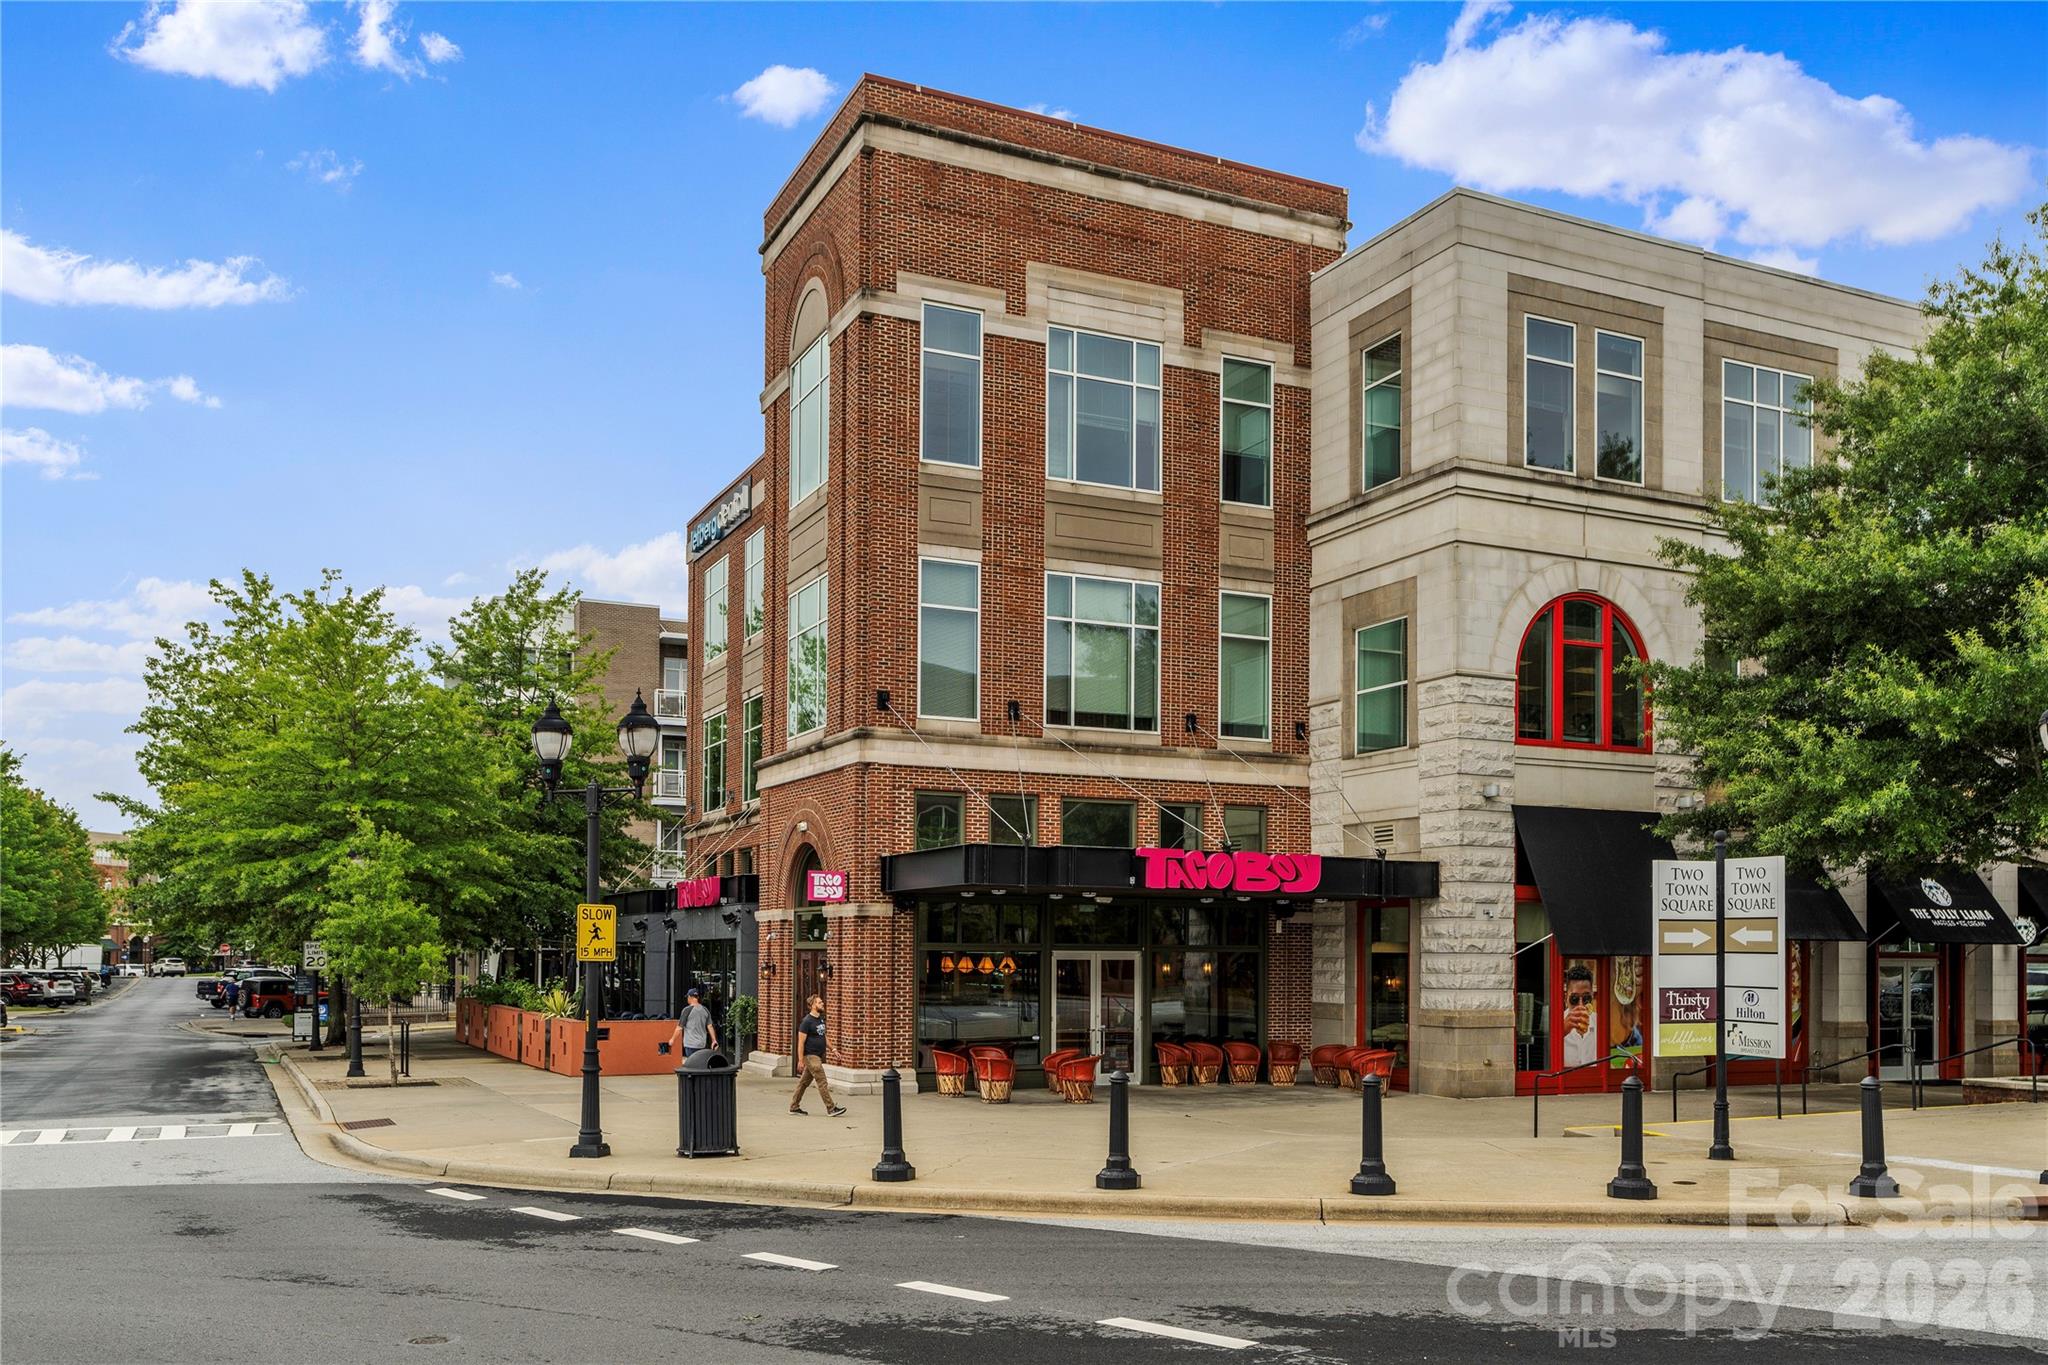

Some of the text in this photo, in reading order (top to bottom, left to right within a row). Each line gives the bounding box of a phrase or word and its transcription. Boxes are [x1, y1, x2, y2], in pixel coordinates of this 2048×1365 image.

[811, 873, 842, 886] TACO
[1671, 867, 1704, 881] TWO
[1736, 867, 1766, 879] TWO
[813, 885, 843, 898] BOY
[1665, 883, 1708, 896] TOWN
[1731, 882, 1771, 895] TOWN
[1661, 898, 1714, 914] SQUARE
[1727, 898, 1776, 913] SQUARE
[582, 908, 612, 920] SLOW
[1910, 908, 1994, 920] THE DOLLY LLAMA
[580, 947, 612, 956] 15 MPH
[306, 956, 326, 967] 20
[1671, 1008, 1706, 1020] Monk
[1737, 1007, 1765, 1020] Hilton
